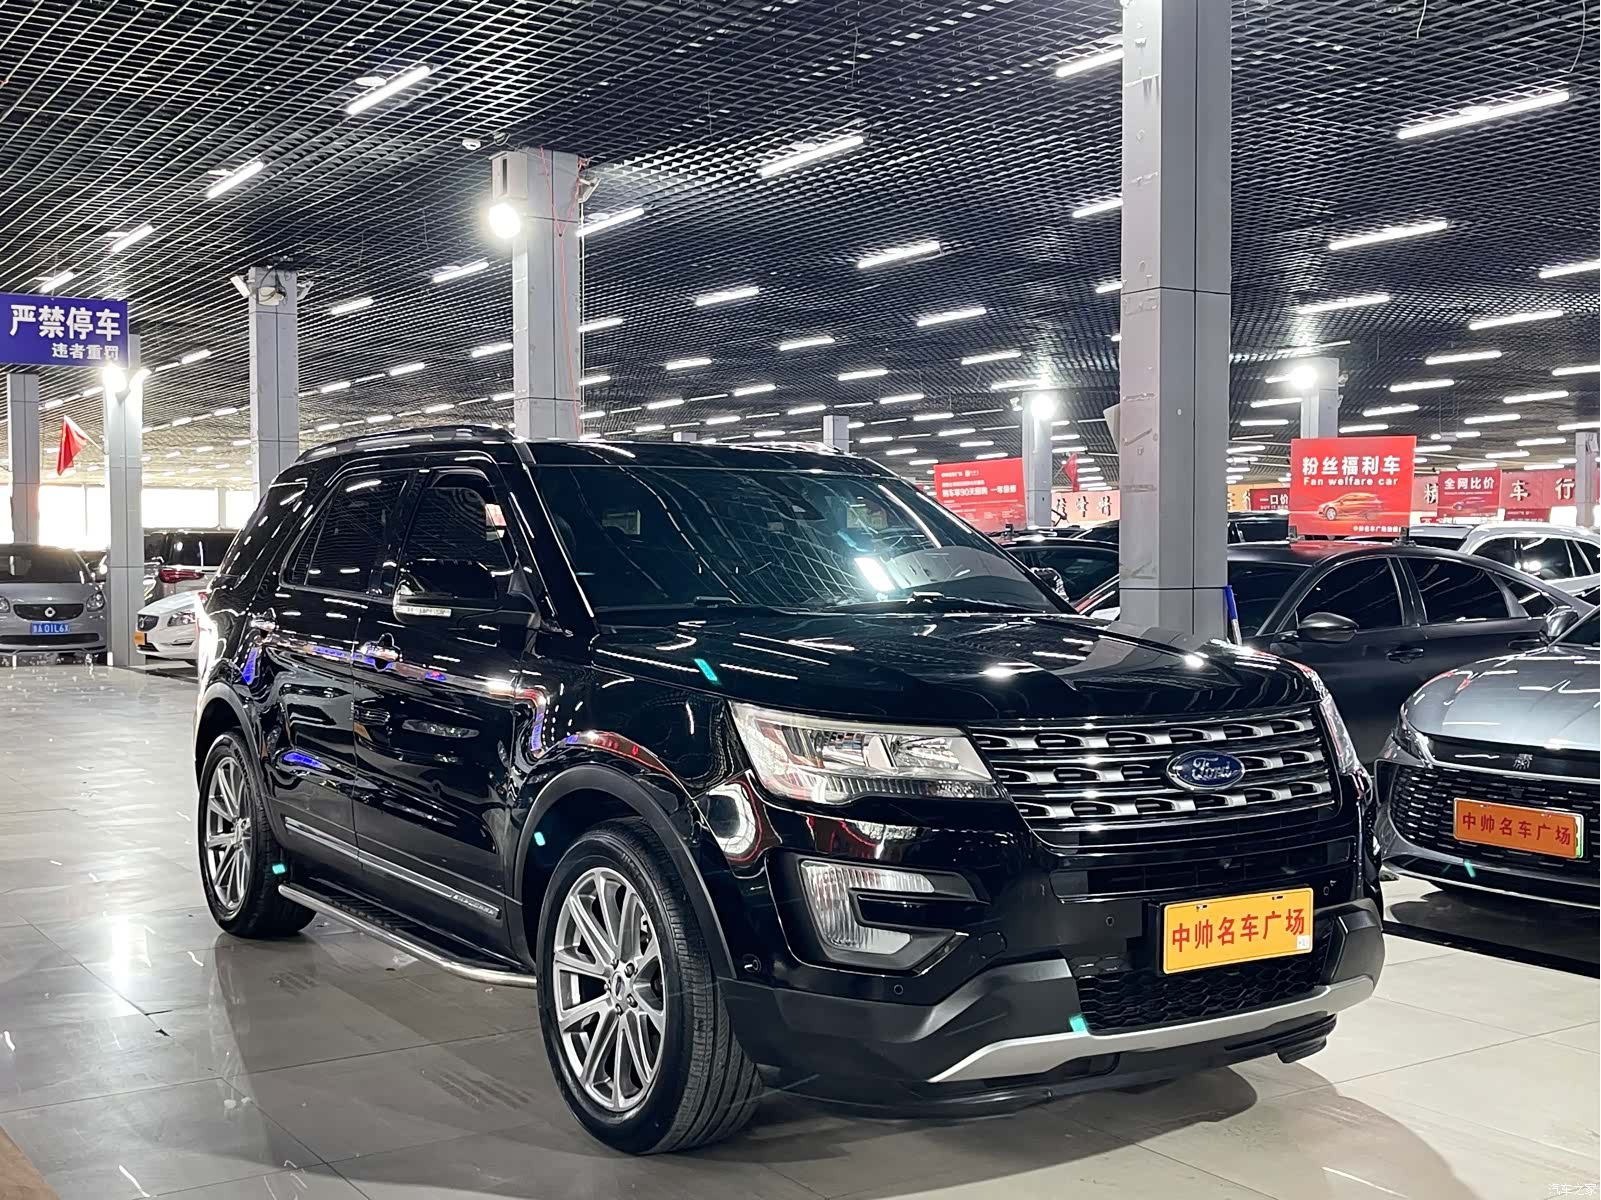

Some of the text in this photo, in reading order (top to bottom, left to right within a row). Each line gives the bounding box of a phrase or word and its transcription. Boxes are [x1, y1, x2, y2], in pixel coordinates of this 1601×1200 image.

[9, 304, 121, 341] 严禁停车
[51, 342, 119, 360] 违者重罚
[1302, 455, 1401, 476] 粉丝福利车
[1303, 475, 1398, 486] Fan welfare car
[1444, 476, 1495, 490] 全网比价
[1259, 493, 1289, 505] 一口价
[1191, 757, 1231, 781] Ford
[1462, 812, 1571, 846] 中帅名车广场
[1172, 908, 1305, 953] 中帅名车广场
